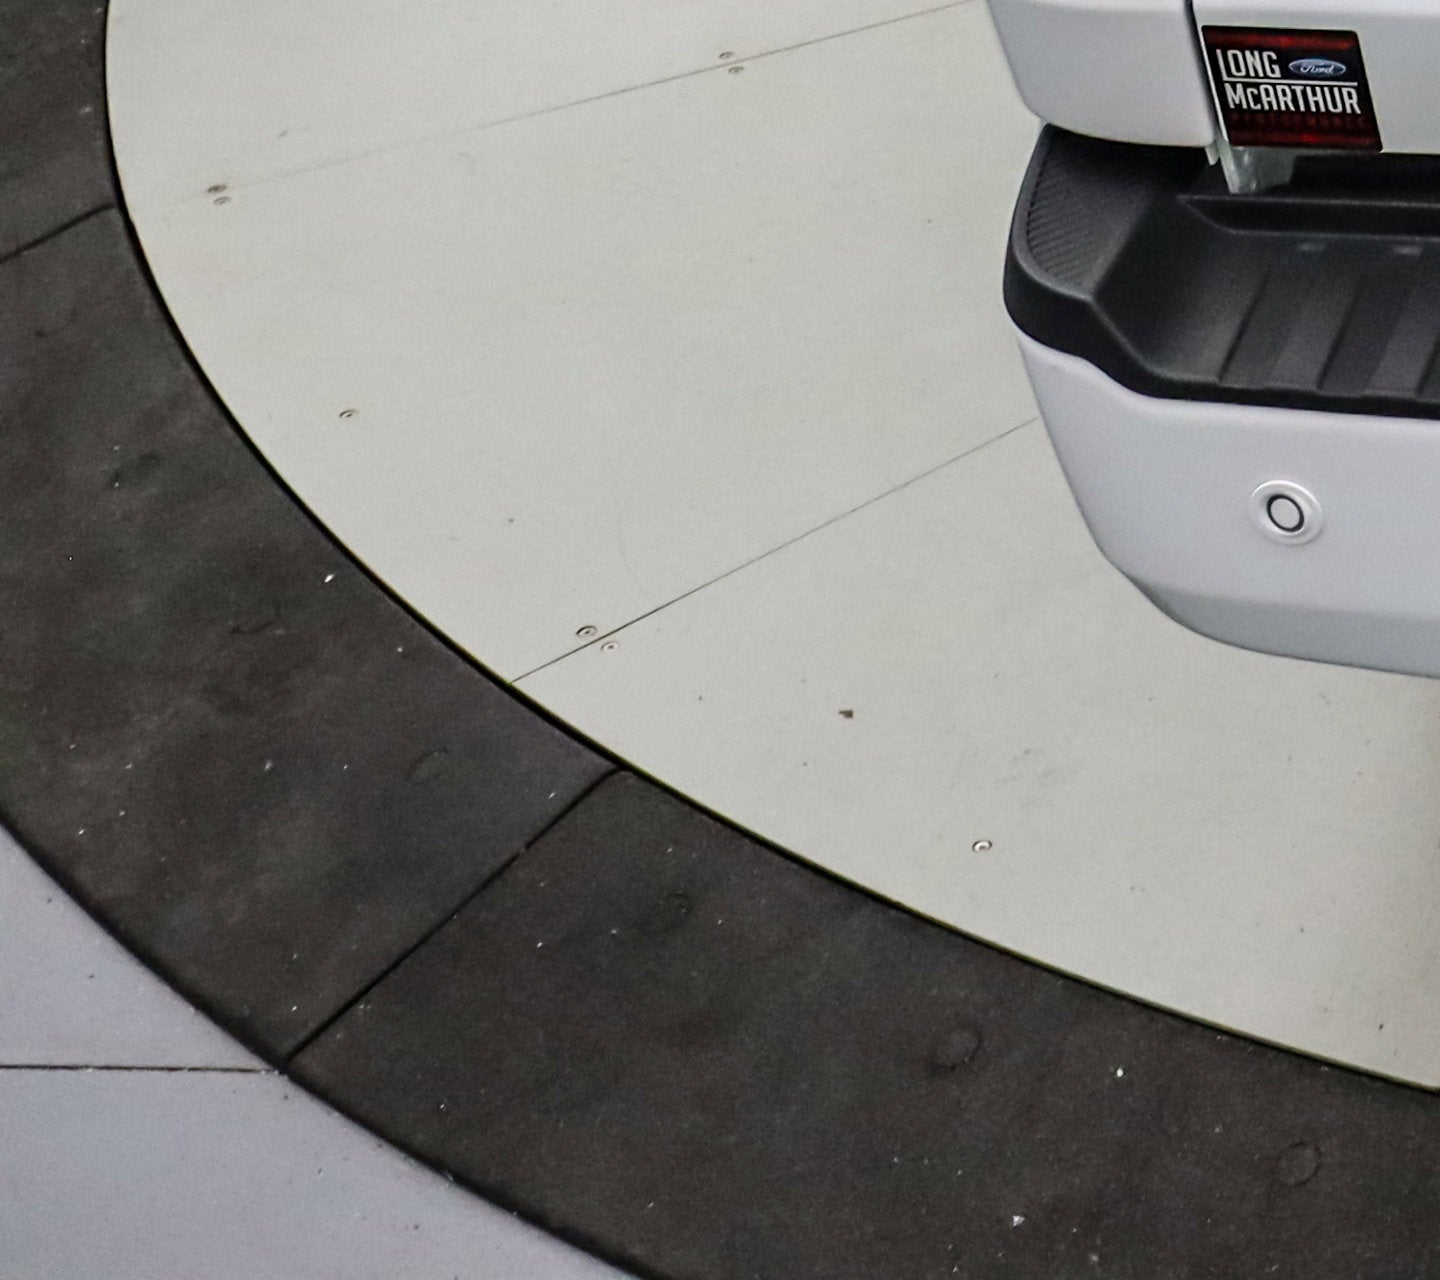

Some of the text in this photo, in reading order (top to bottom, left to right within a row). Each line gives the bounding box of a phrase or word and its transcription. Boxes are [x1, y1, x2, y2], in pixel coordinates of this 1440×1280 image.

[1216, 49, 1281, 80] LONG
[1299, 60, 1335, 75] Ford
[1223, 82, 1361, 114] McARTHUR
